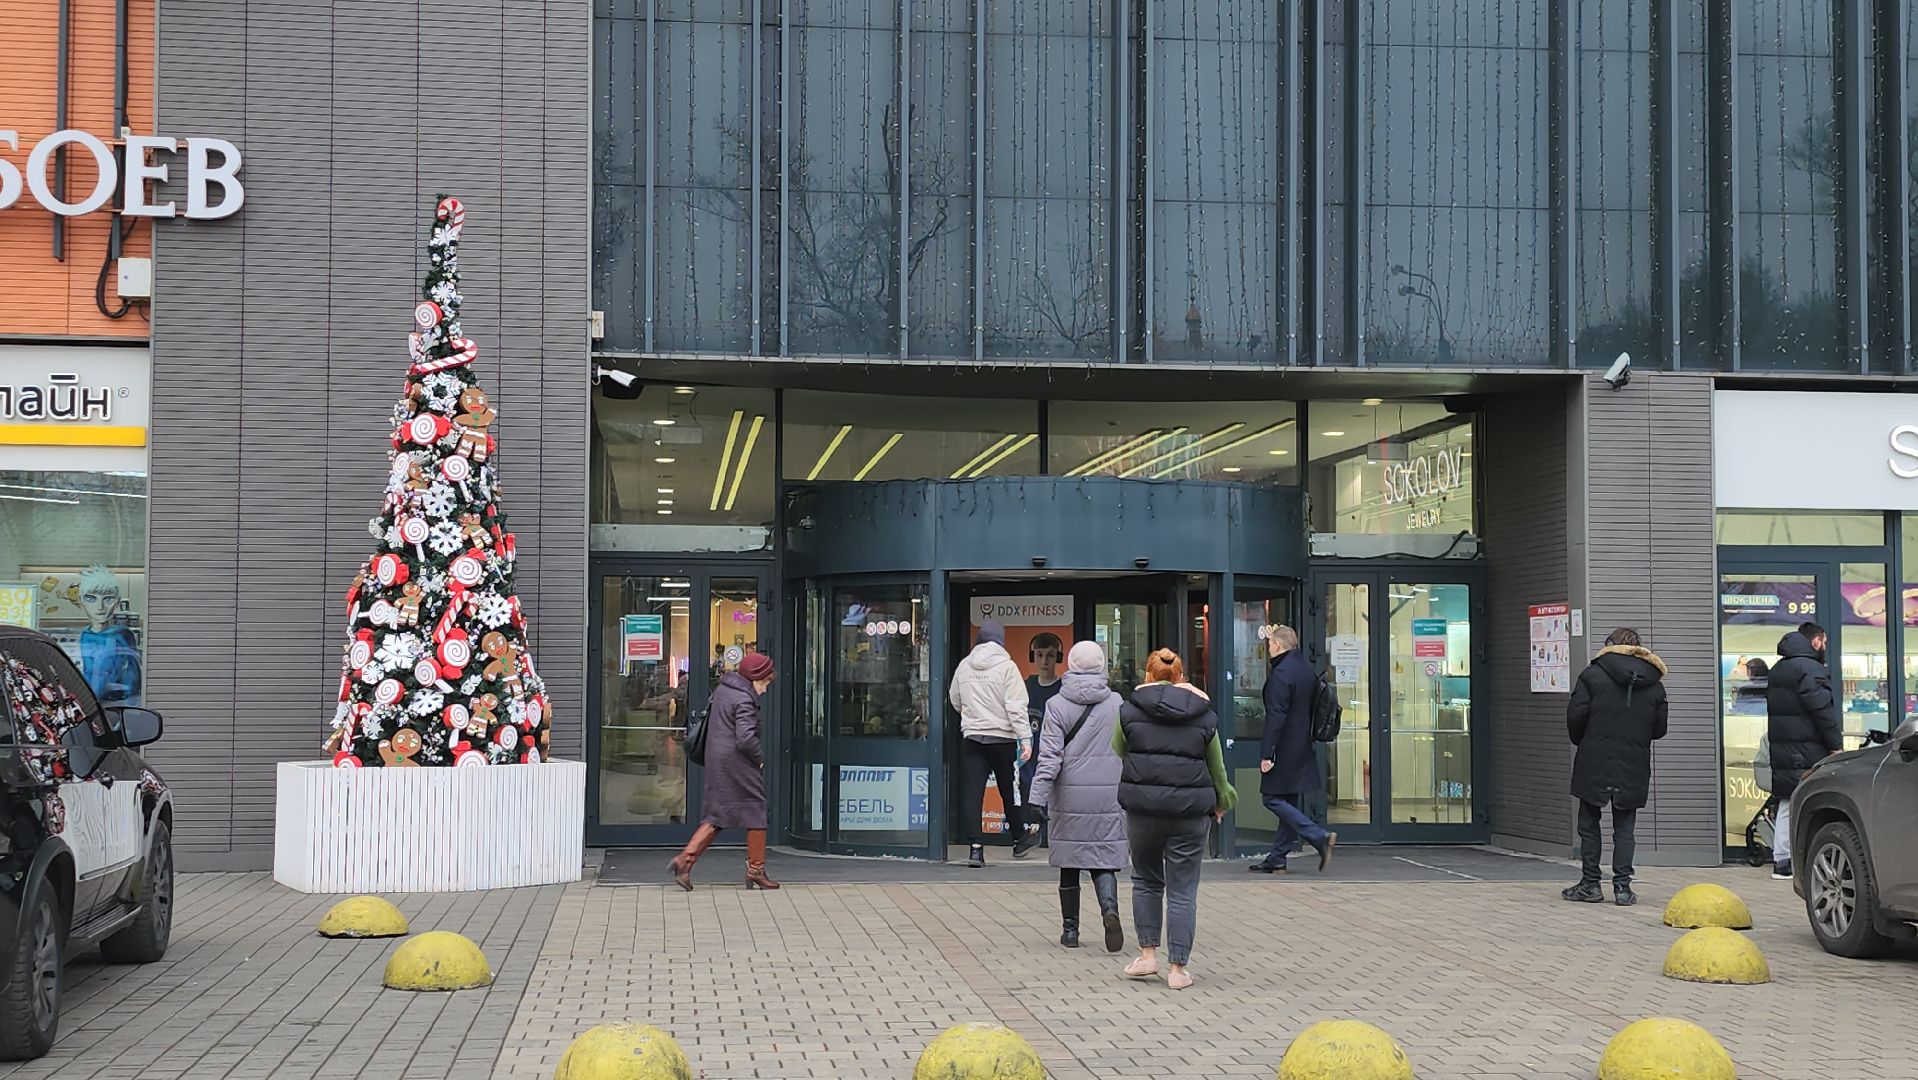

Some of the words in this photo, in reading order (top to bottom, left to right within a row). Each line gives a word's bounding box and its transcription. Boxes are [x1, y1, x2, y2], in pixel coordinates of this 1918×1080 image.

[1383, 446, 1462, 505] SOKOLOV
[1406, 508, 1441, 530] JEWELRY
[997, 605, 1020, 617] DDX
[1022, 605, 1065, 616] FITNESS
[820, 799, 895, 813] ЕБЕЛЬ
